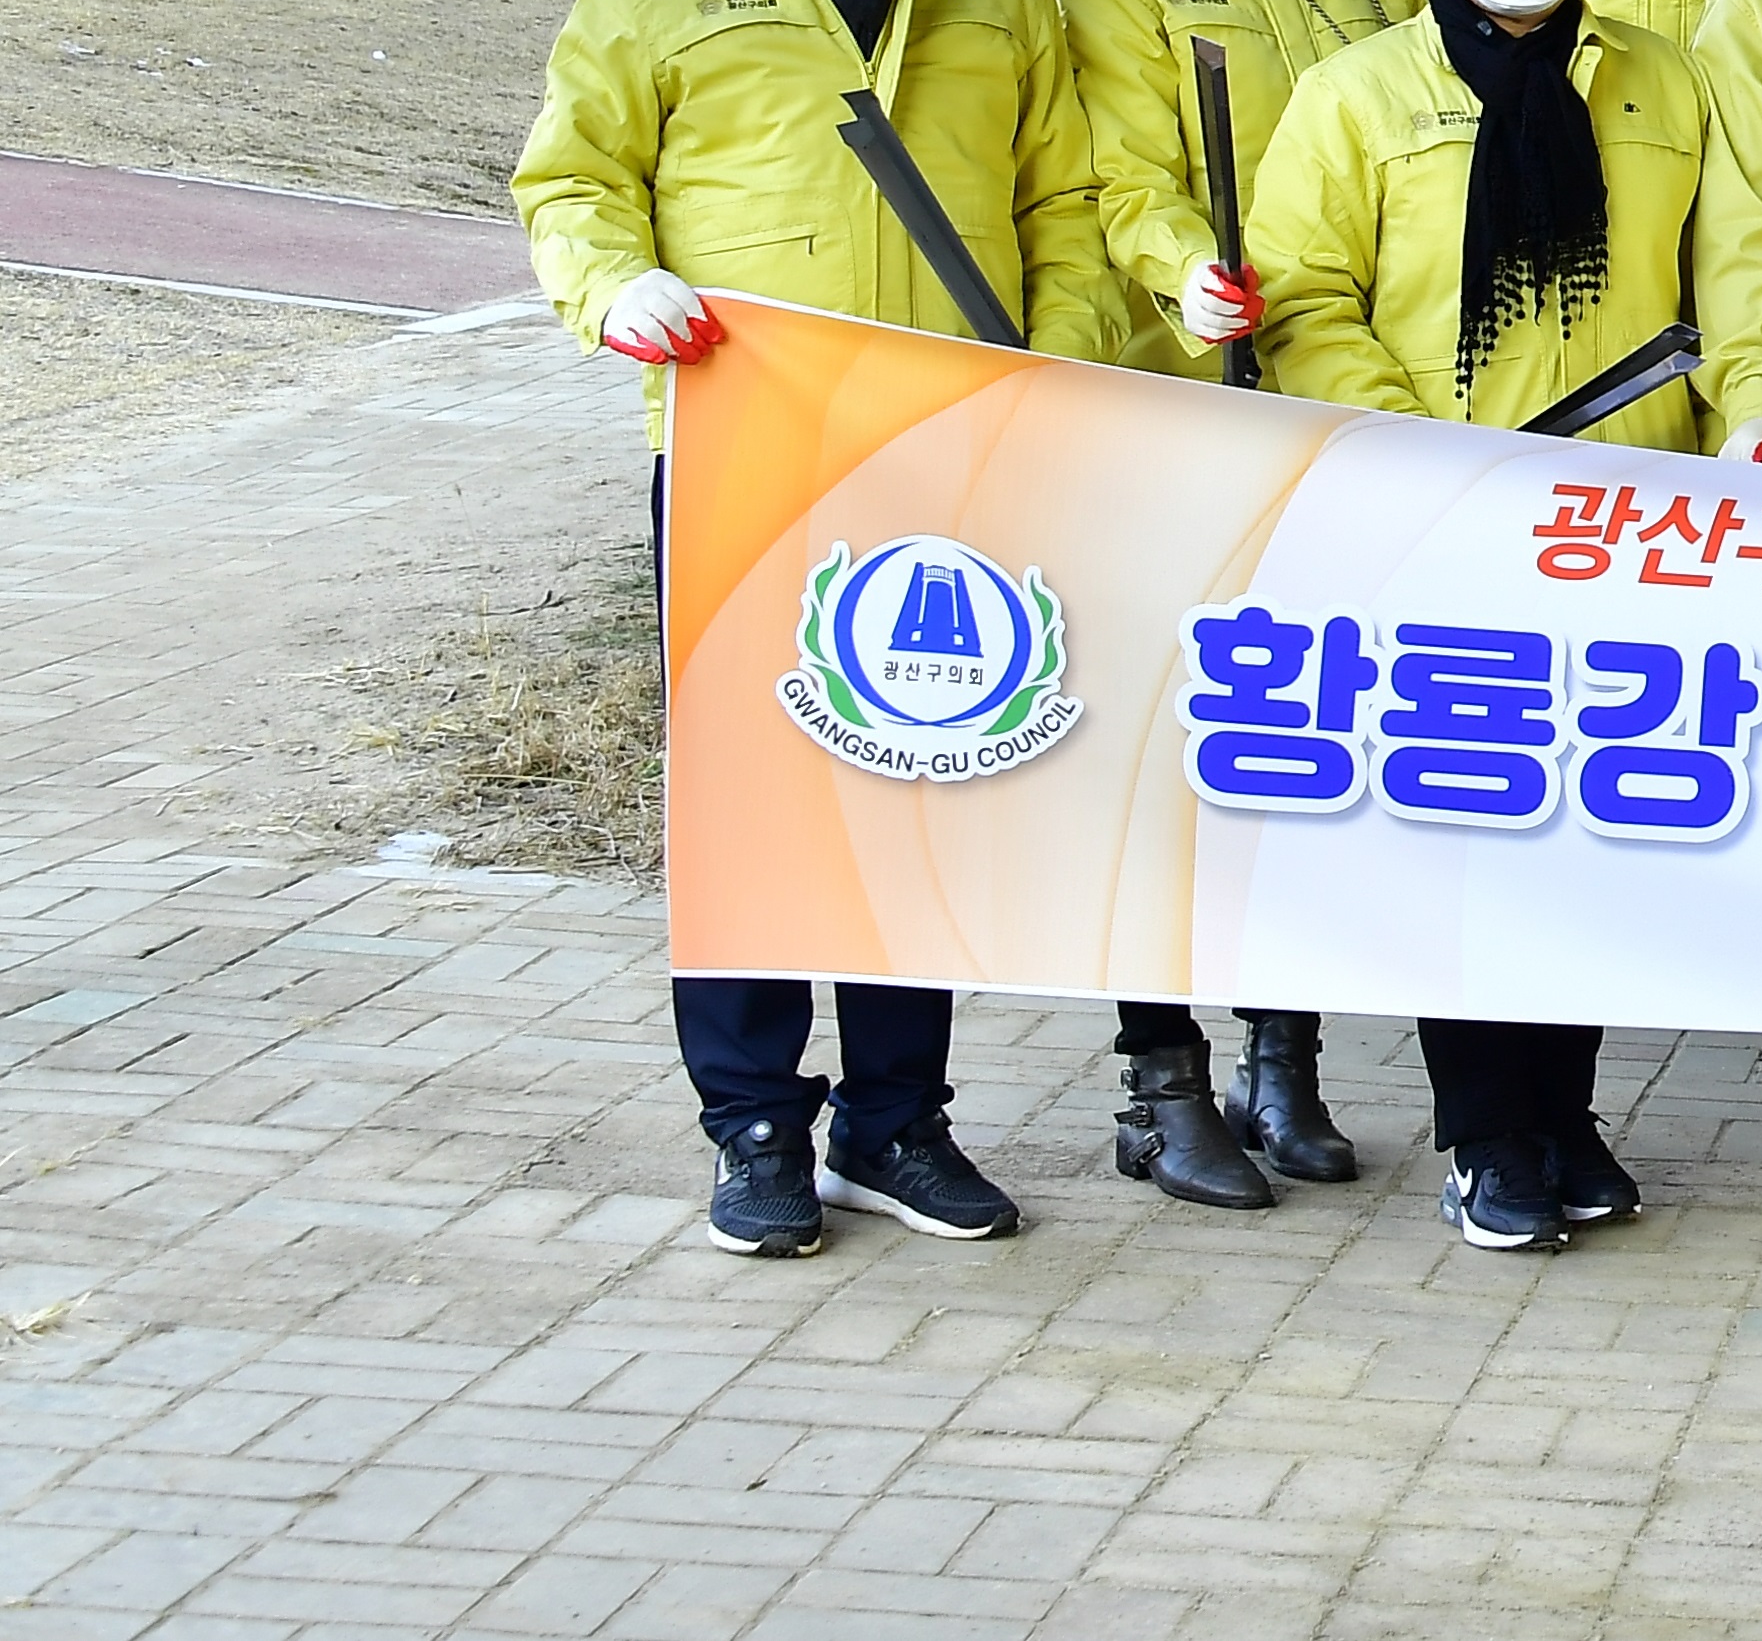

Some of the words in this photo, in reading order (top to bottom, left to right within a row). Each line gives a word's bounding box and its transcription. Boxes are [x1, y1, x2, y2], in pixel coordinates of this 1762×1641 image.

[883, 661, 984, 686] 광산구의회
[1189, 606, 1759, 829] 황룡강
[783, 678, 969, 774] GWANGSAN-GU
[977, 700, 1077, 768] COUNCIL
